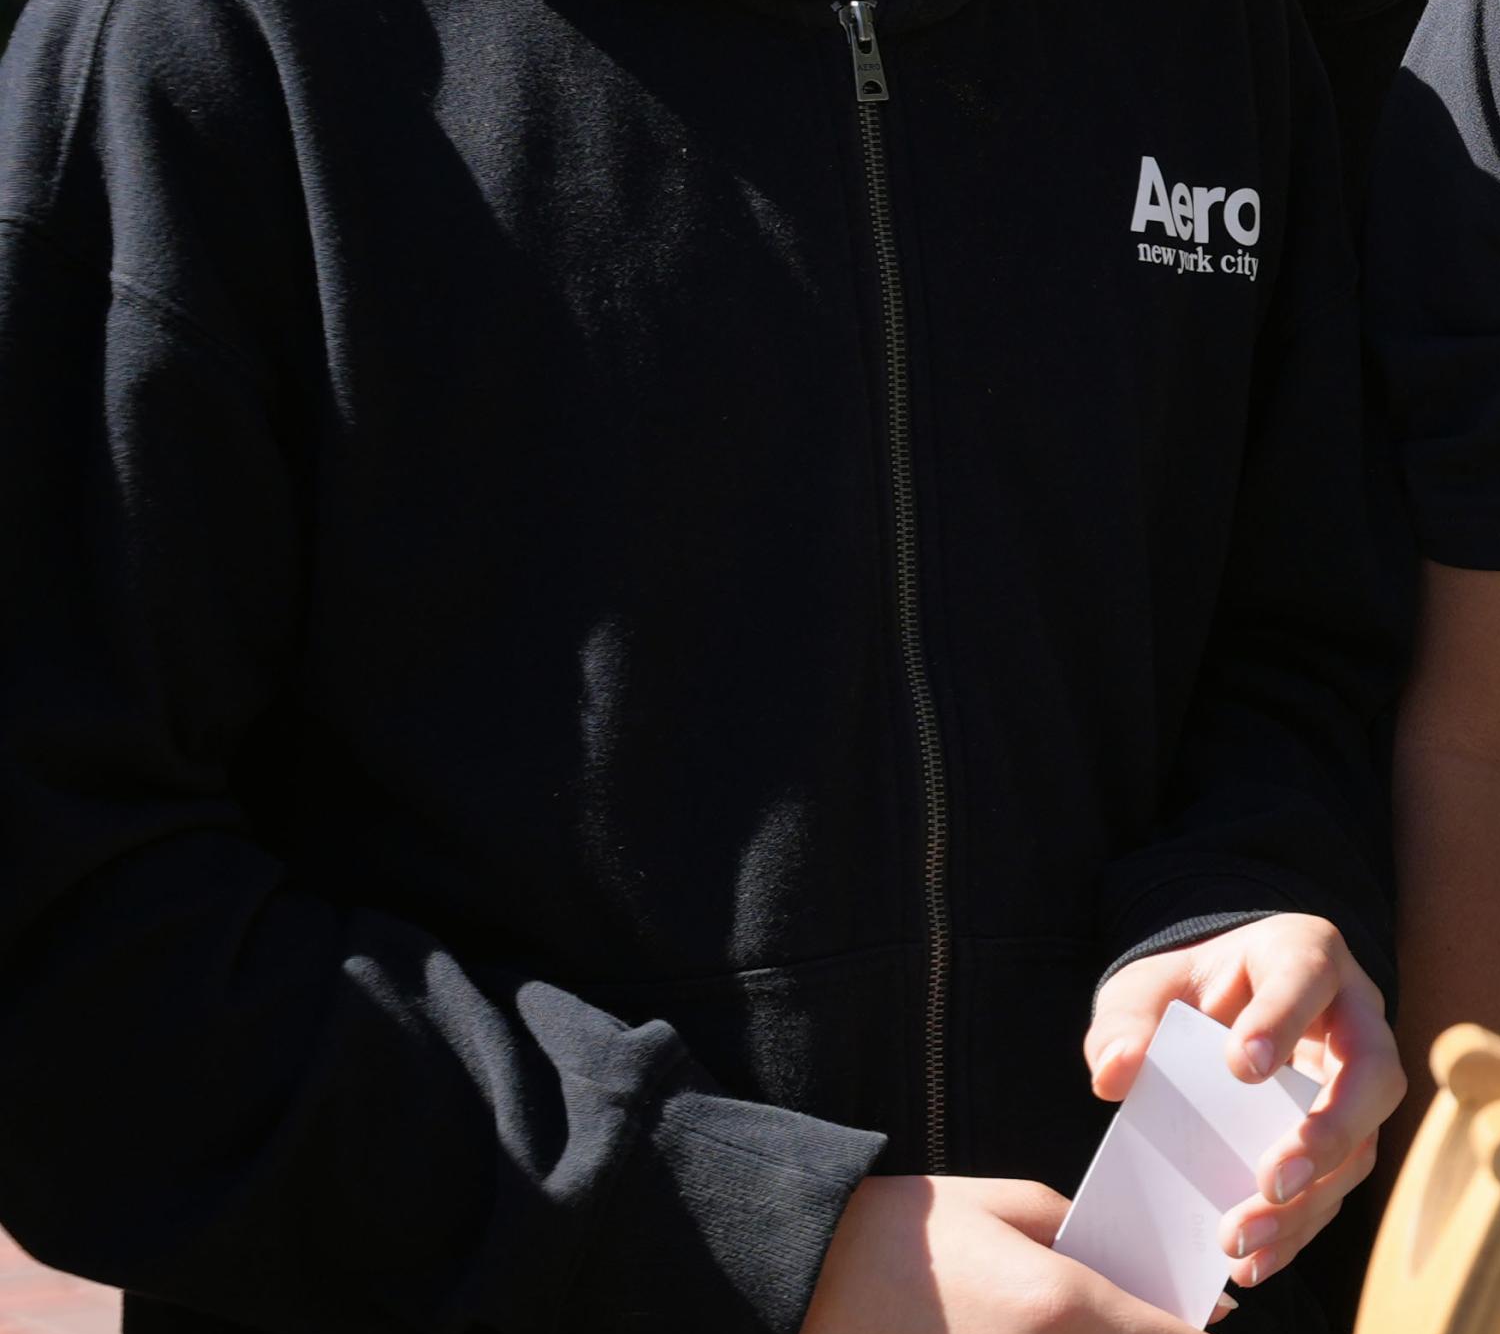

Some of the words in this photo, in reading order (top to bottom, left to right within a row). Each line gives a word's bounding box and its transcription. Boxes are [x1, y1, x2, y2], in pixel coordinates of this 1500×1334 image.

[1130, 155, 1261, 246] Aero
[1137, 243, 1176, 266] new
[1220, 249, 1259, 281] city
